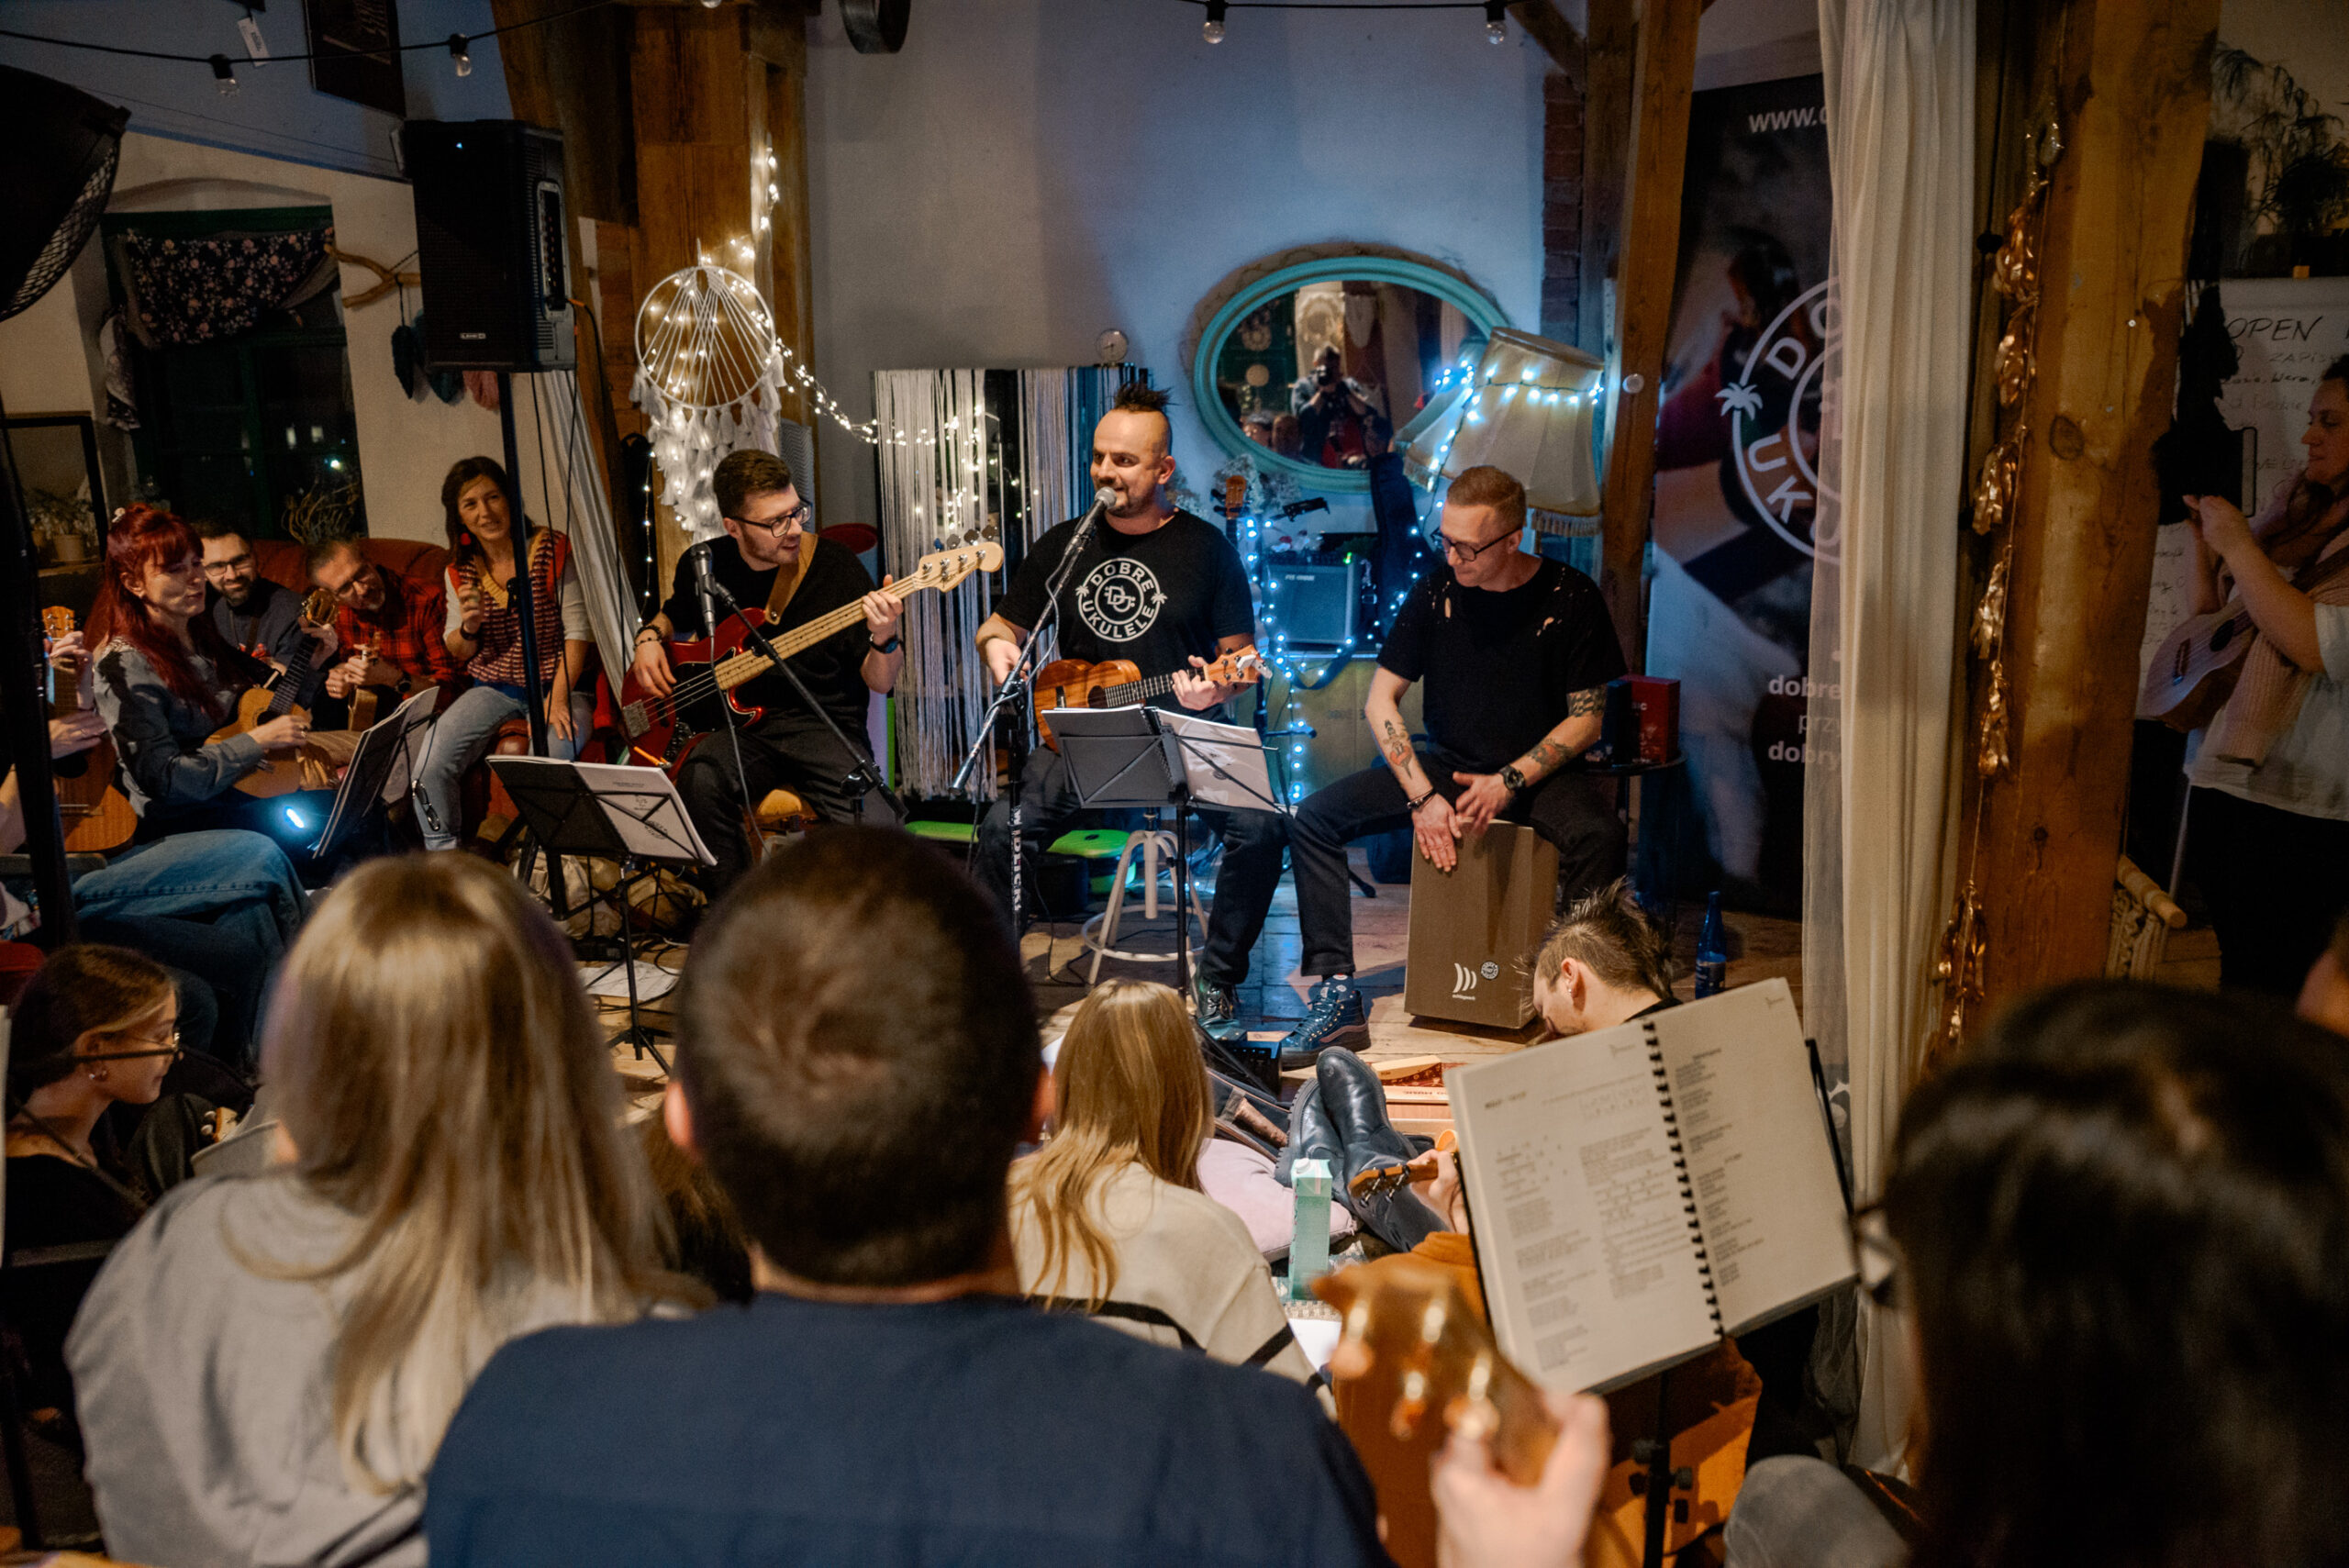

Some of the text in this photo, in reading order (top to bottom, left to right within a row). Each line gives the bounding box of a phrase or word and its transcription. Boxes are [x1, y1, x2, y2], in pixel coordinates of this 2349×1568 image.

[2226, 316, 2323, 341] OPEN
[1090, 562, 1154, 592] DOBRE
[1083, 599, 1155, 639] UKULELE
